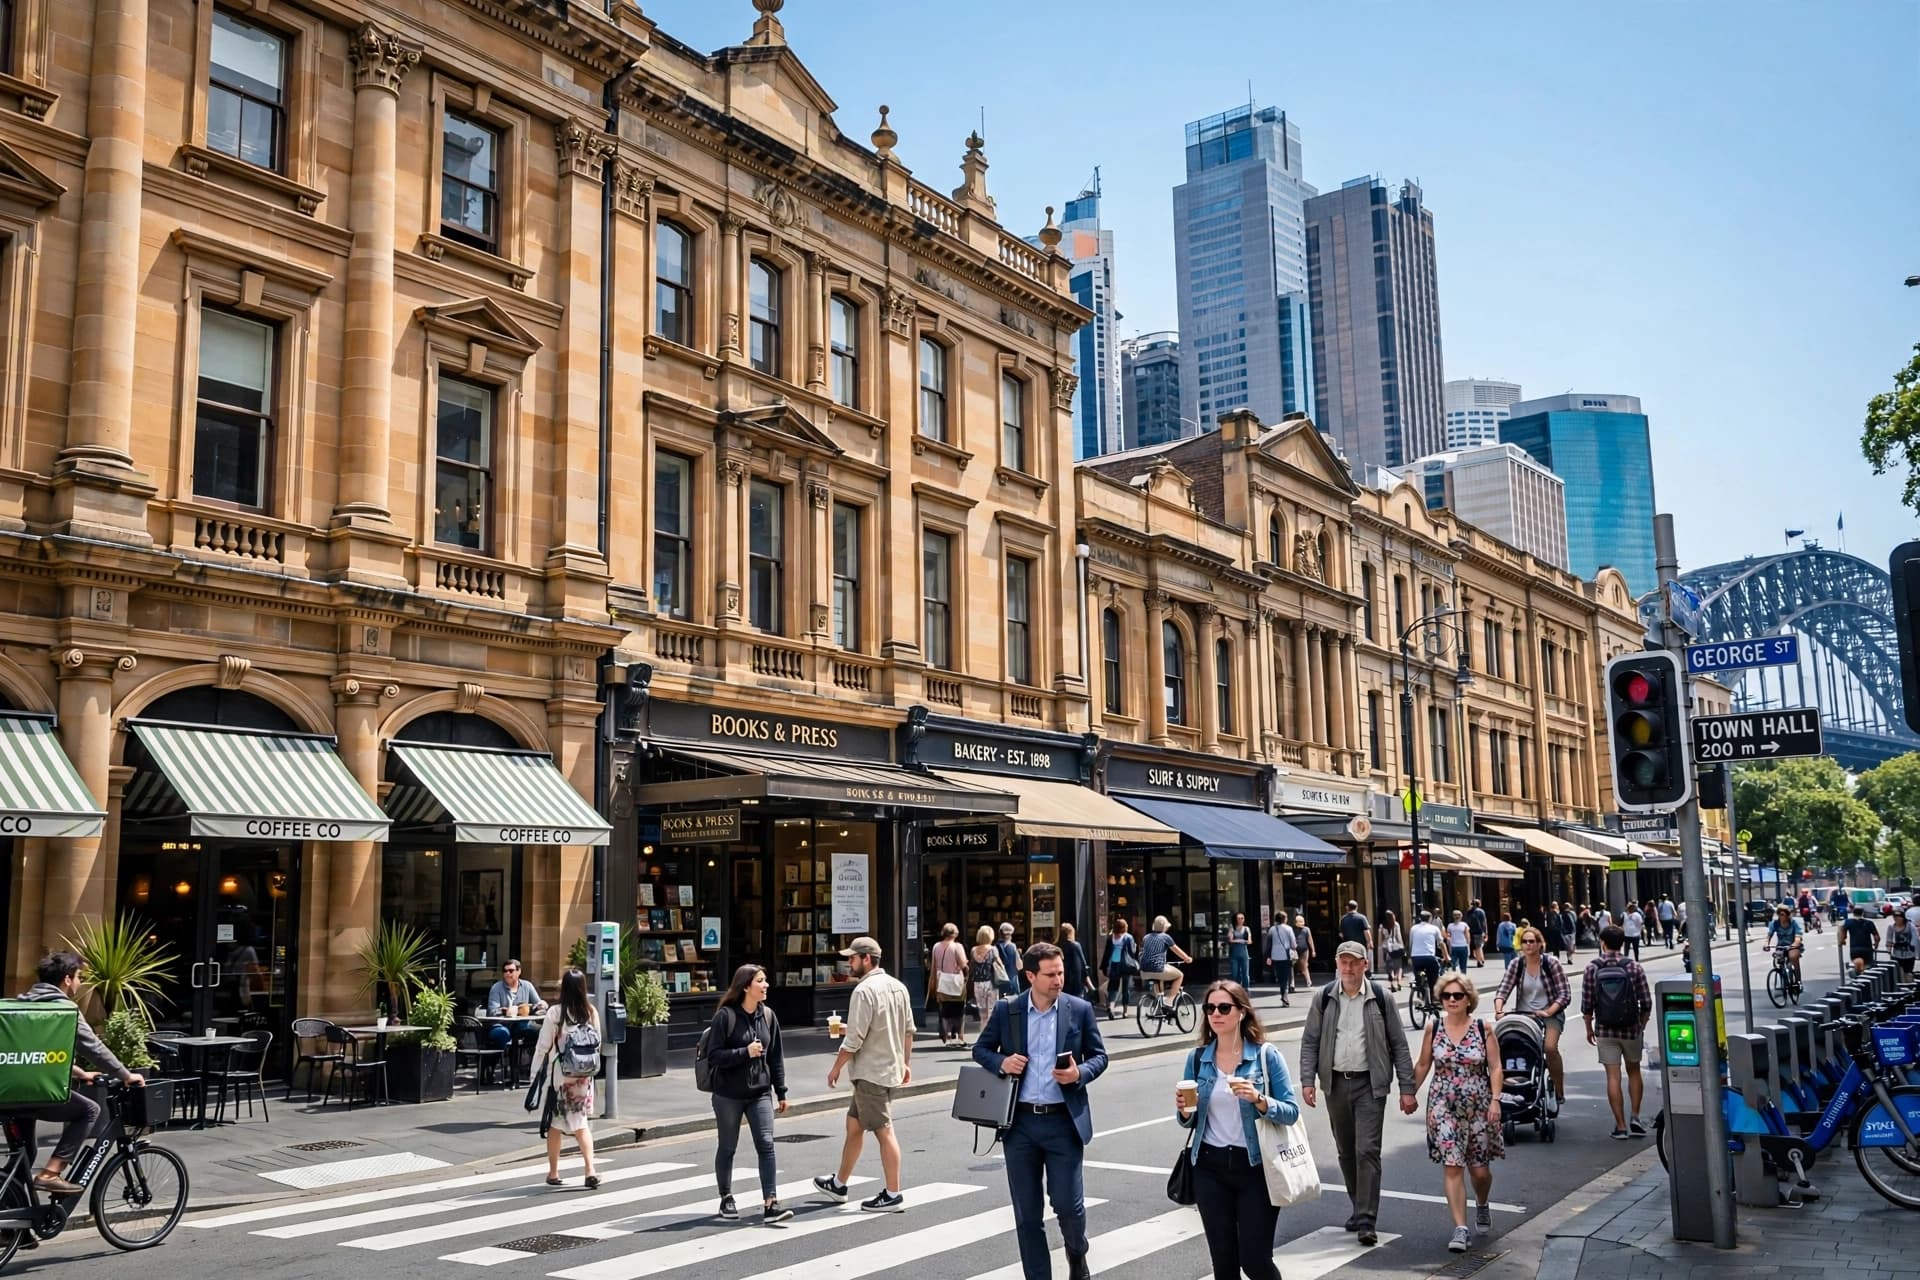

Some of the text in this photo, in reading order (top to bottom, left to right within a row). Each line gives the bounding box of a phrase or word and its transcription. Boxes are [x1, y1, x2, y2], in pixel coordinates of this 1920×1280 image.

[1692, 640, 1790, 668] GEORGE ST
[711, 713, 838, 748] BOOKS & PRESS
[1698, 714, 1814, 740] TOWN HALL
[954, 742, 998, 762] BAKERY
[1007, 749, 1028, 766] EST.
[1030, 752, 1051, 768] 1898
[1701, 742, 1755, 758] 200 m
[1148, 768, 1220, 793] SURF & SUPPLY
[0, 815, 32, 834] CO
[246, 820, 341, 839] COFFEE CO
[499, 828, 571, 844] COFFEE CO
[0, 1051, 67, 1065] DELIVEROO
